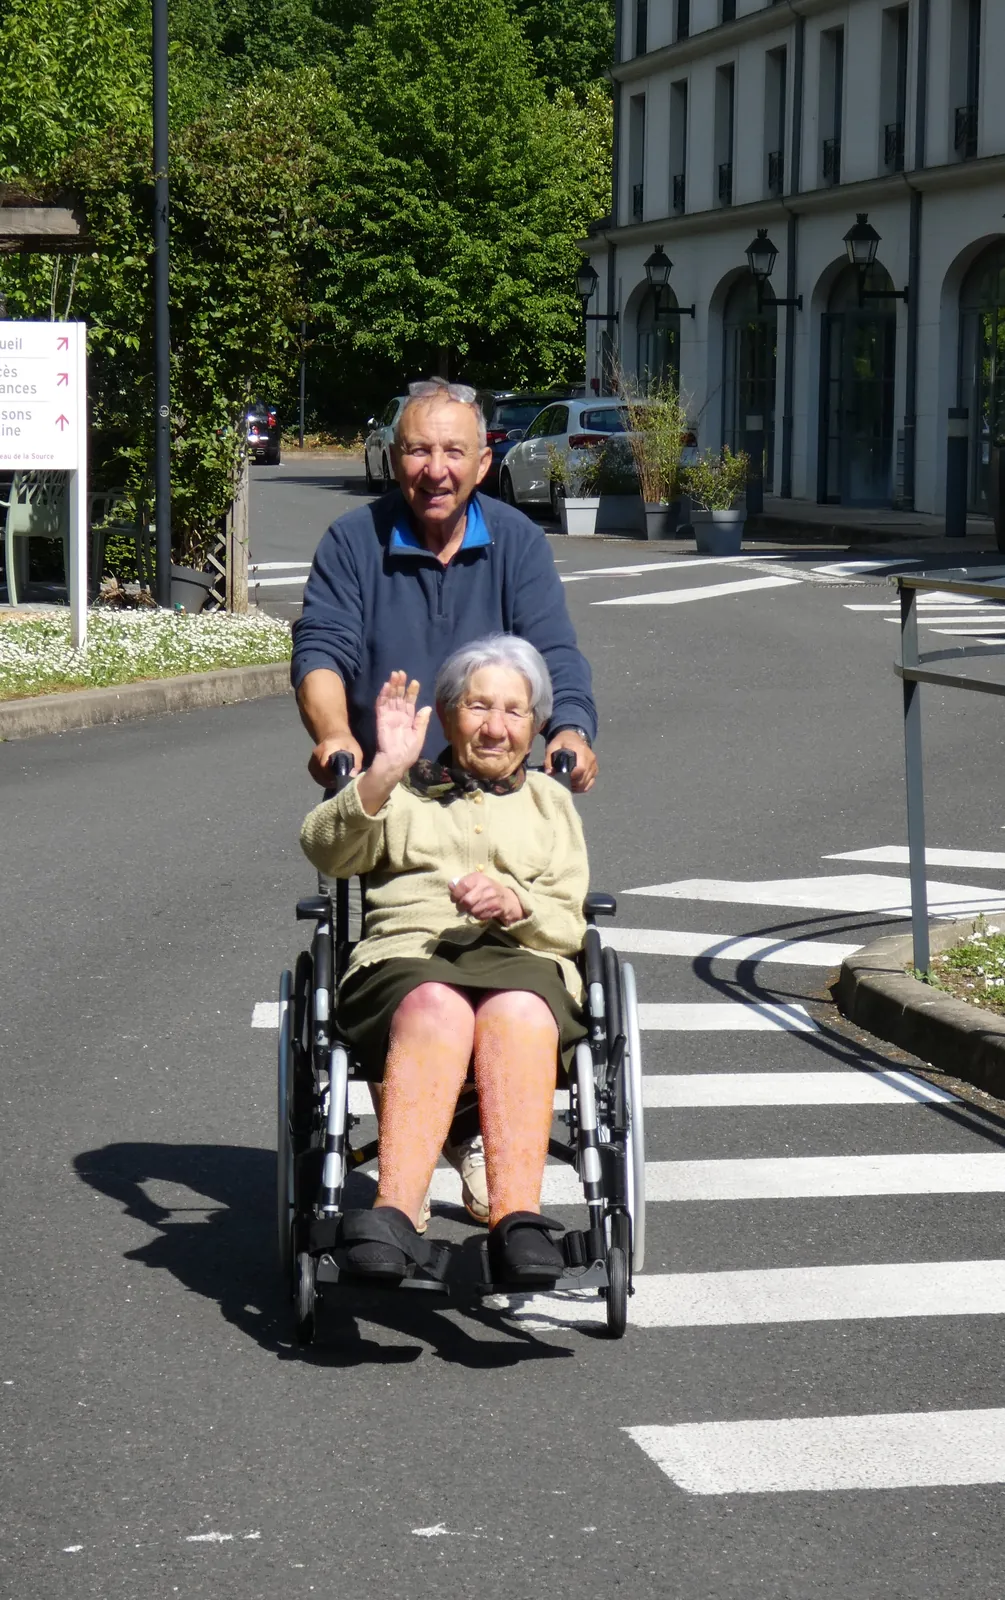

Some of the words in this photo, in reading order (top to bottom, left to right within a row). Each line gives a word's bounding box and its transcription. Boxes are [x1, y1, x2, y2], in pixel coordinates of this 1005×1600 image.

[0, 337, 22, 350] ueil
[0, 384, 37, 394] ances
[1, 410, 32, 420] sons
[1, 424, 21, 436] ine
